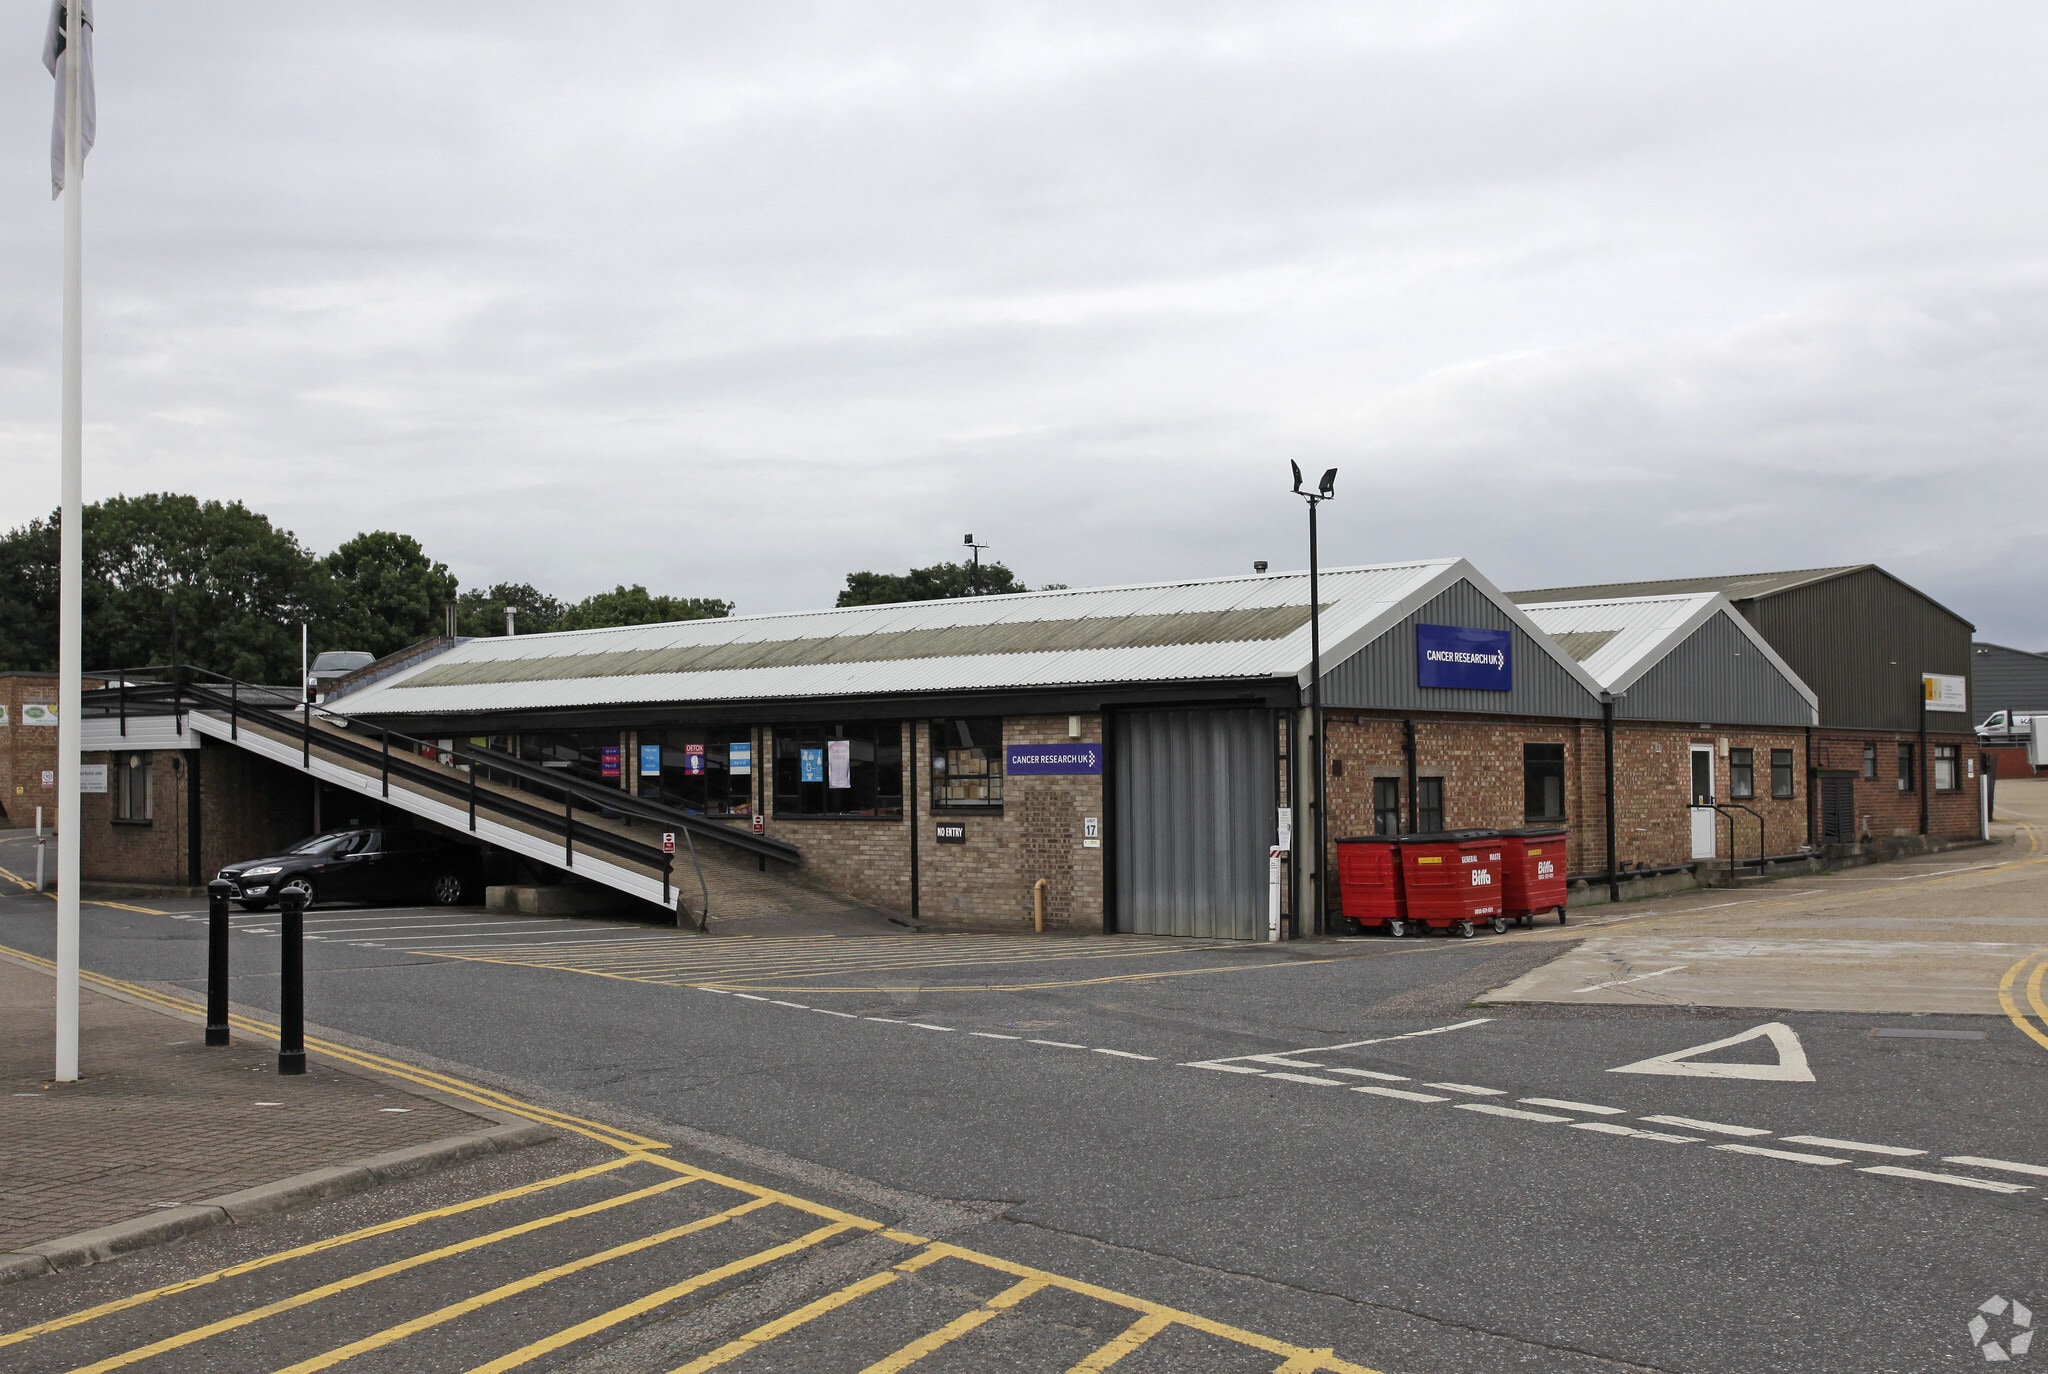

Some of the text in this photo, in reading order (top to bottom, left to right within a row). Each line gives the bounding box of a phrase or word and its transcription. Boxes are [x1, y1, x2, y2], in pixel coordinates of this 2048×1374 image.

[1426, 650, 1498, 665] CANCER RESEARCH UK
[686, 744, 704, 752] DETOX
[1012, 754, 1088, 764] CANCER RESEARCH UK
[937, 827, 963, 837] NO ENTRY
[1086, 824, 1096, 836] 17
[1538, 860, 1554, 874] Biffa
[1471, 868, 1491, 886] Biffa
